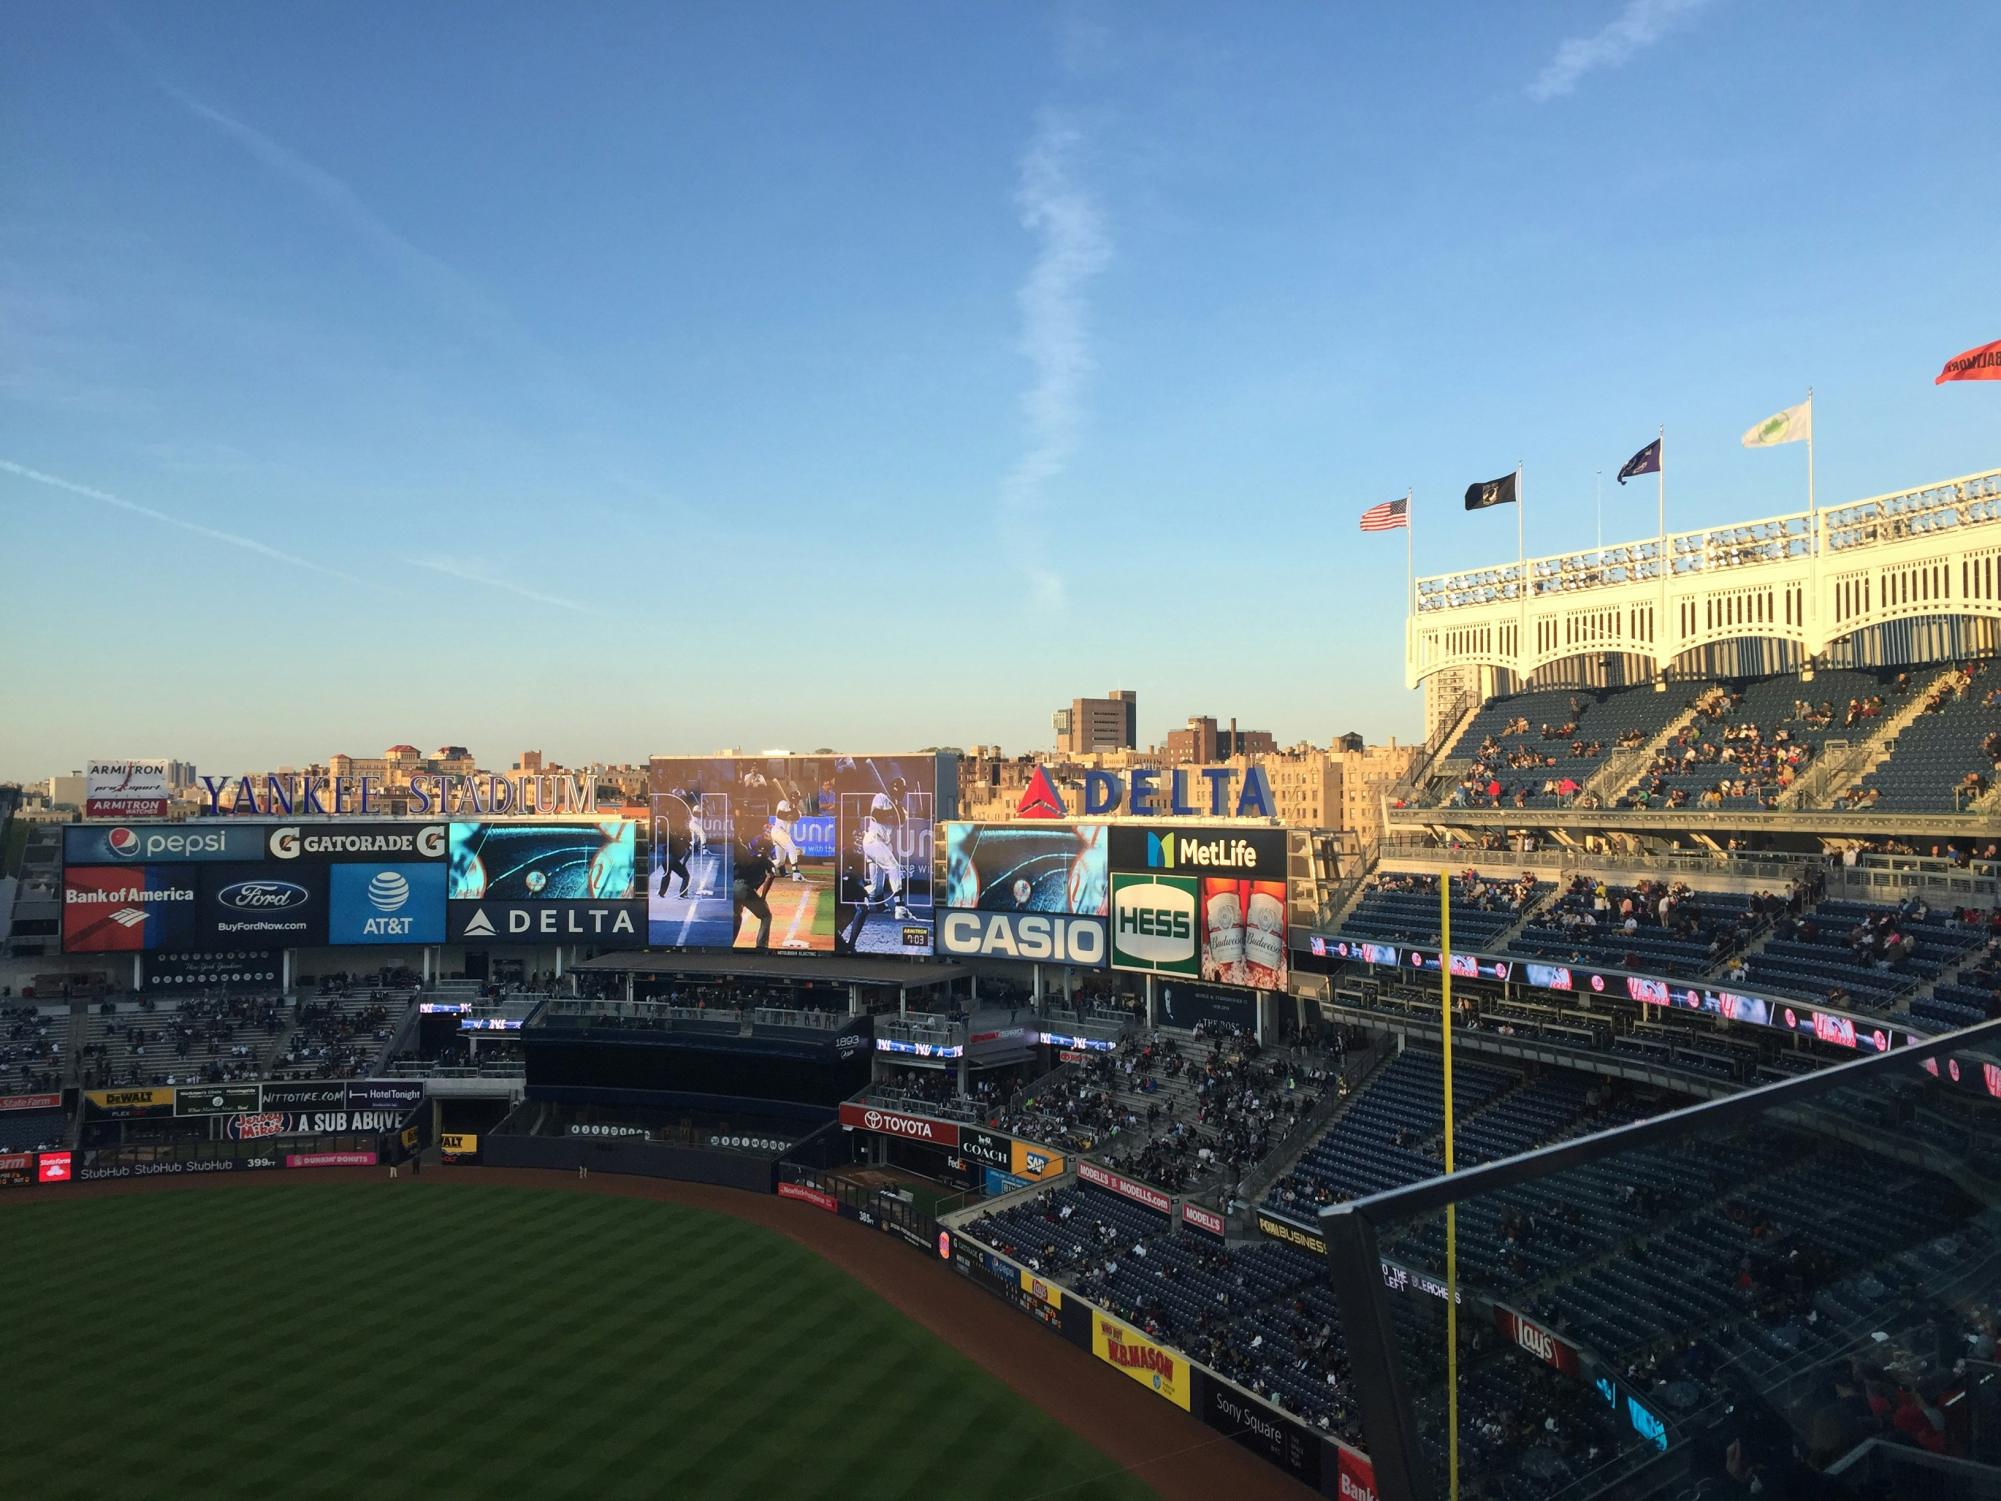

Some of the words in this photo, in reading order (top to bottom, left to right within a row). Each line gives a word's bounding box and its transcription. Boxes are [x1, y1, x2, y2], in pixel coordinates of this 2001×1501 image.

[90, 765, 164, 775] ARMITRON
[199, 775, 380, 816] YANKEE
[408, 774, 598, 815] STADIUM
[1085, 767, 1278, 817] DELTA
[93, 801, 160, 809] ARMITRON
[147, 831, 225, 857] pepsi
[269, 827, 300, 860] G
[303, 835, 413, 852] GATORADE
[416, 826, 445, 857] G
[1181, 838, 1257, 867] MetLife
[66, 889, 108, 904] Bank
[109, 888, 126, 902] of
[127, 887, 194, 901] America
[236, 884, 290, 906] Ford
[218, 921, 307, 932] BuyFordNow.com
[363, 917, 413, 935] AT&T
[509, 909, 635, 933] DELTA
[1119, 906, 1191, 940] HESS
[943, 912, 1104, 965] CASIO
[835, 1034, 860, 1048] 1893
[262, 1090, 345, 1104] NITTOTIRE.COM
[369, 1089, 421, 1101] HotelTonight
[236, 1112, 283, 1126] Jersey
[298, 1113, 309, 1132] A
[314, 1113, 347, 1131] SUB
[352, 1111, 403, 1130] ABOVE
[884, 1116, 933, 1138] TOYOTA
[336, 1155, 368, 1163] DONUTS
[963, 1142, 1007, 1164] COACH
[81, 1166, 130, 1180] StubHub
[135, 1163, 182, 1175] StubHub
[186, 1159, 233, 1172] StubHub
[1027, 1154, 1045, 1173] SAP
[1120, 1180, 1169, 1210] MODELLS.com
[1384, 1275, 1405, 1292] LEFT
[1392, 1267, 1408, 1284] THE
[1411, 1275, 1462, 1305] BLEACHES
[1216, 1392, 1242, 1423] Sony
[1244, 1407, 1282, 1445] Square
